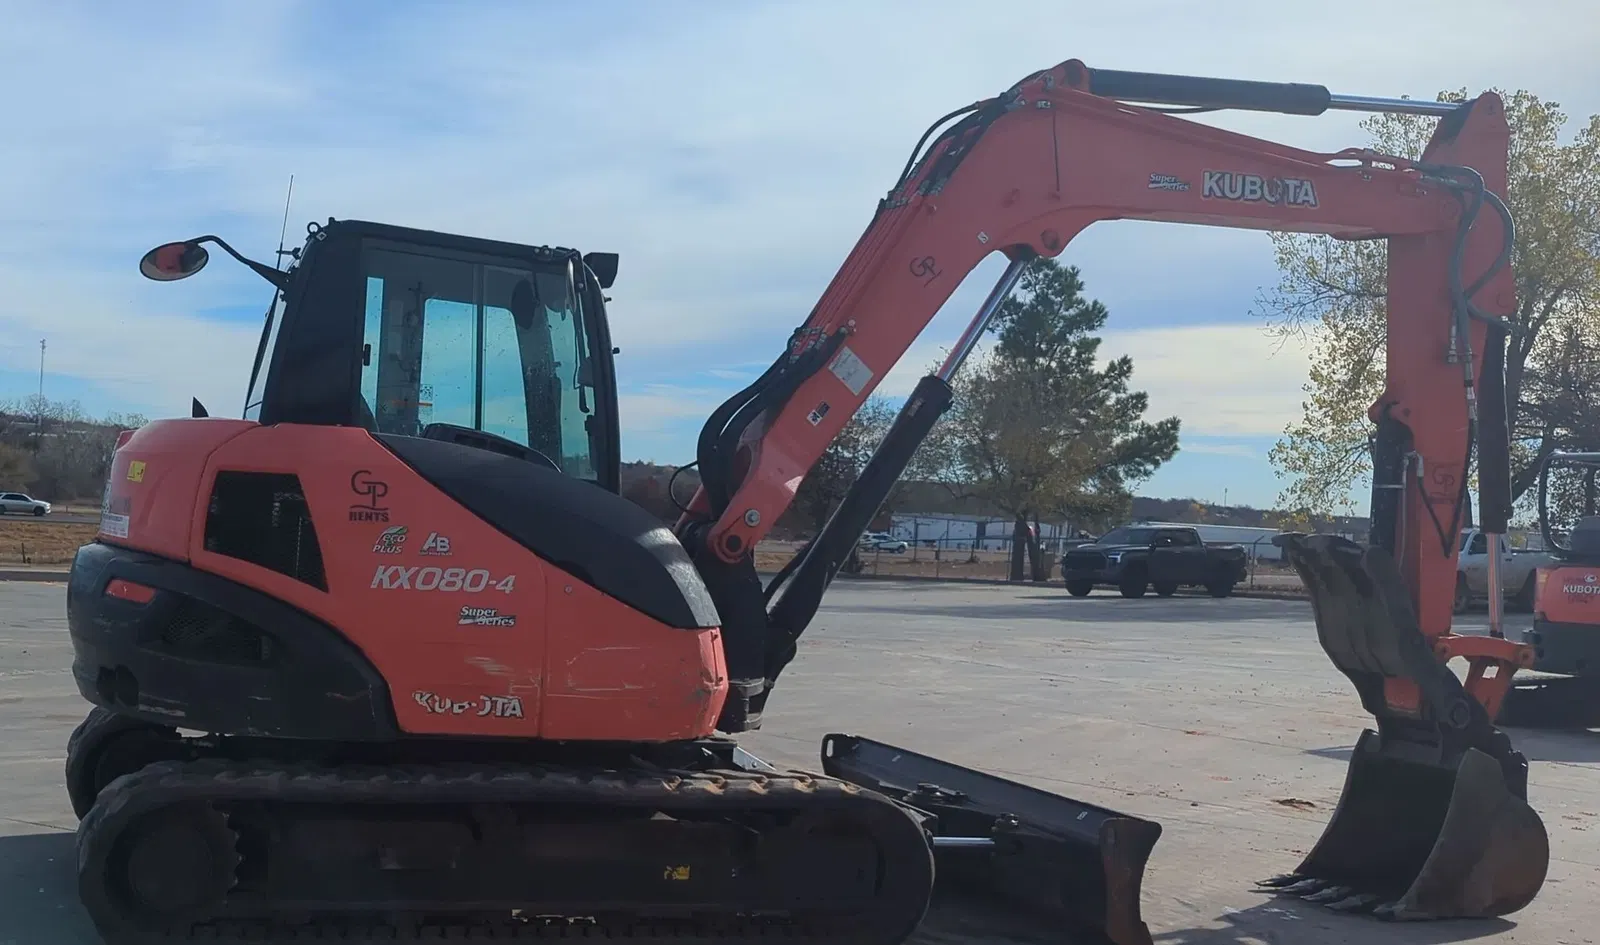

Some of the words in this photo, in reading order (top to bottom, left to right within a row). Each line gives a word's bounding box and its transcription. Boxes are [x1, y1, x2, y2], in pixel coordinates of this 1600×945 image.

[1150, 173, 1176, 182] Super
[1203, 171, 1317, 207] KUBOTA
[351, 470, 388, 507] GP
[349, 511, 389, 522] RENTS
[382, 534, 406, 543] eco
[373, 545, 402, 554] PLUS
[370, 566, 516, 594] KX080-4
[461, 605, 497, 617] Super
[477, 616, 515, 626] Series
